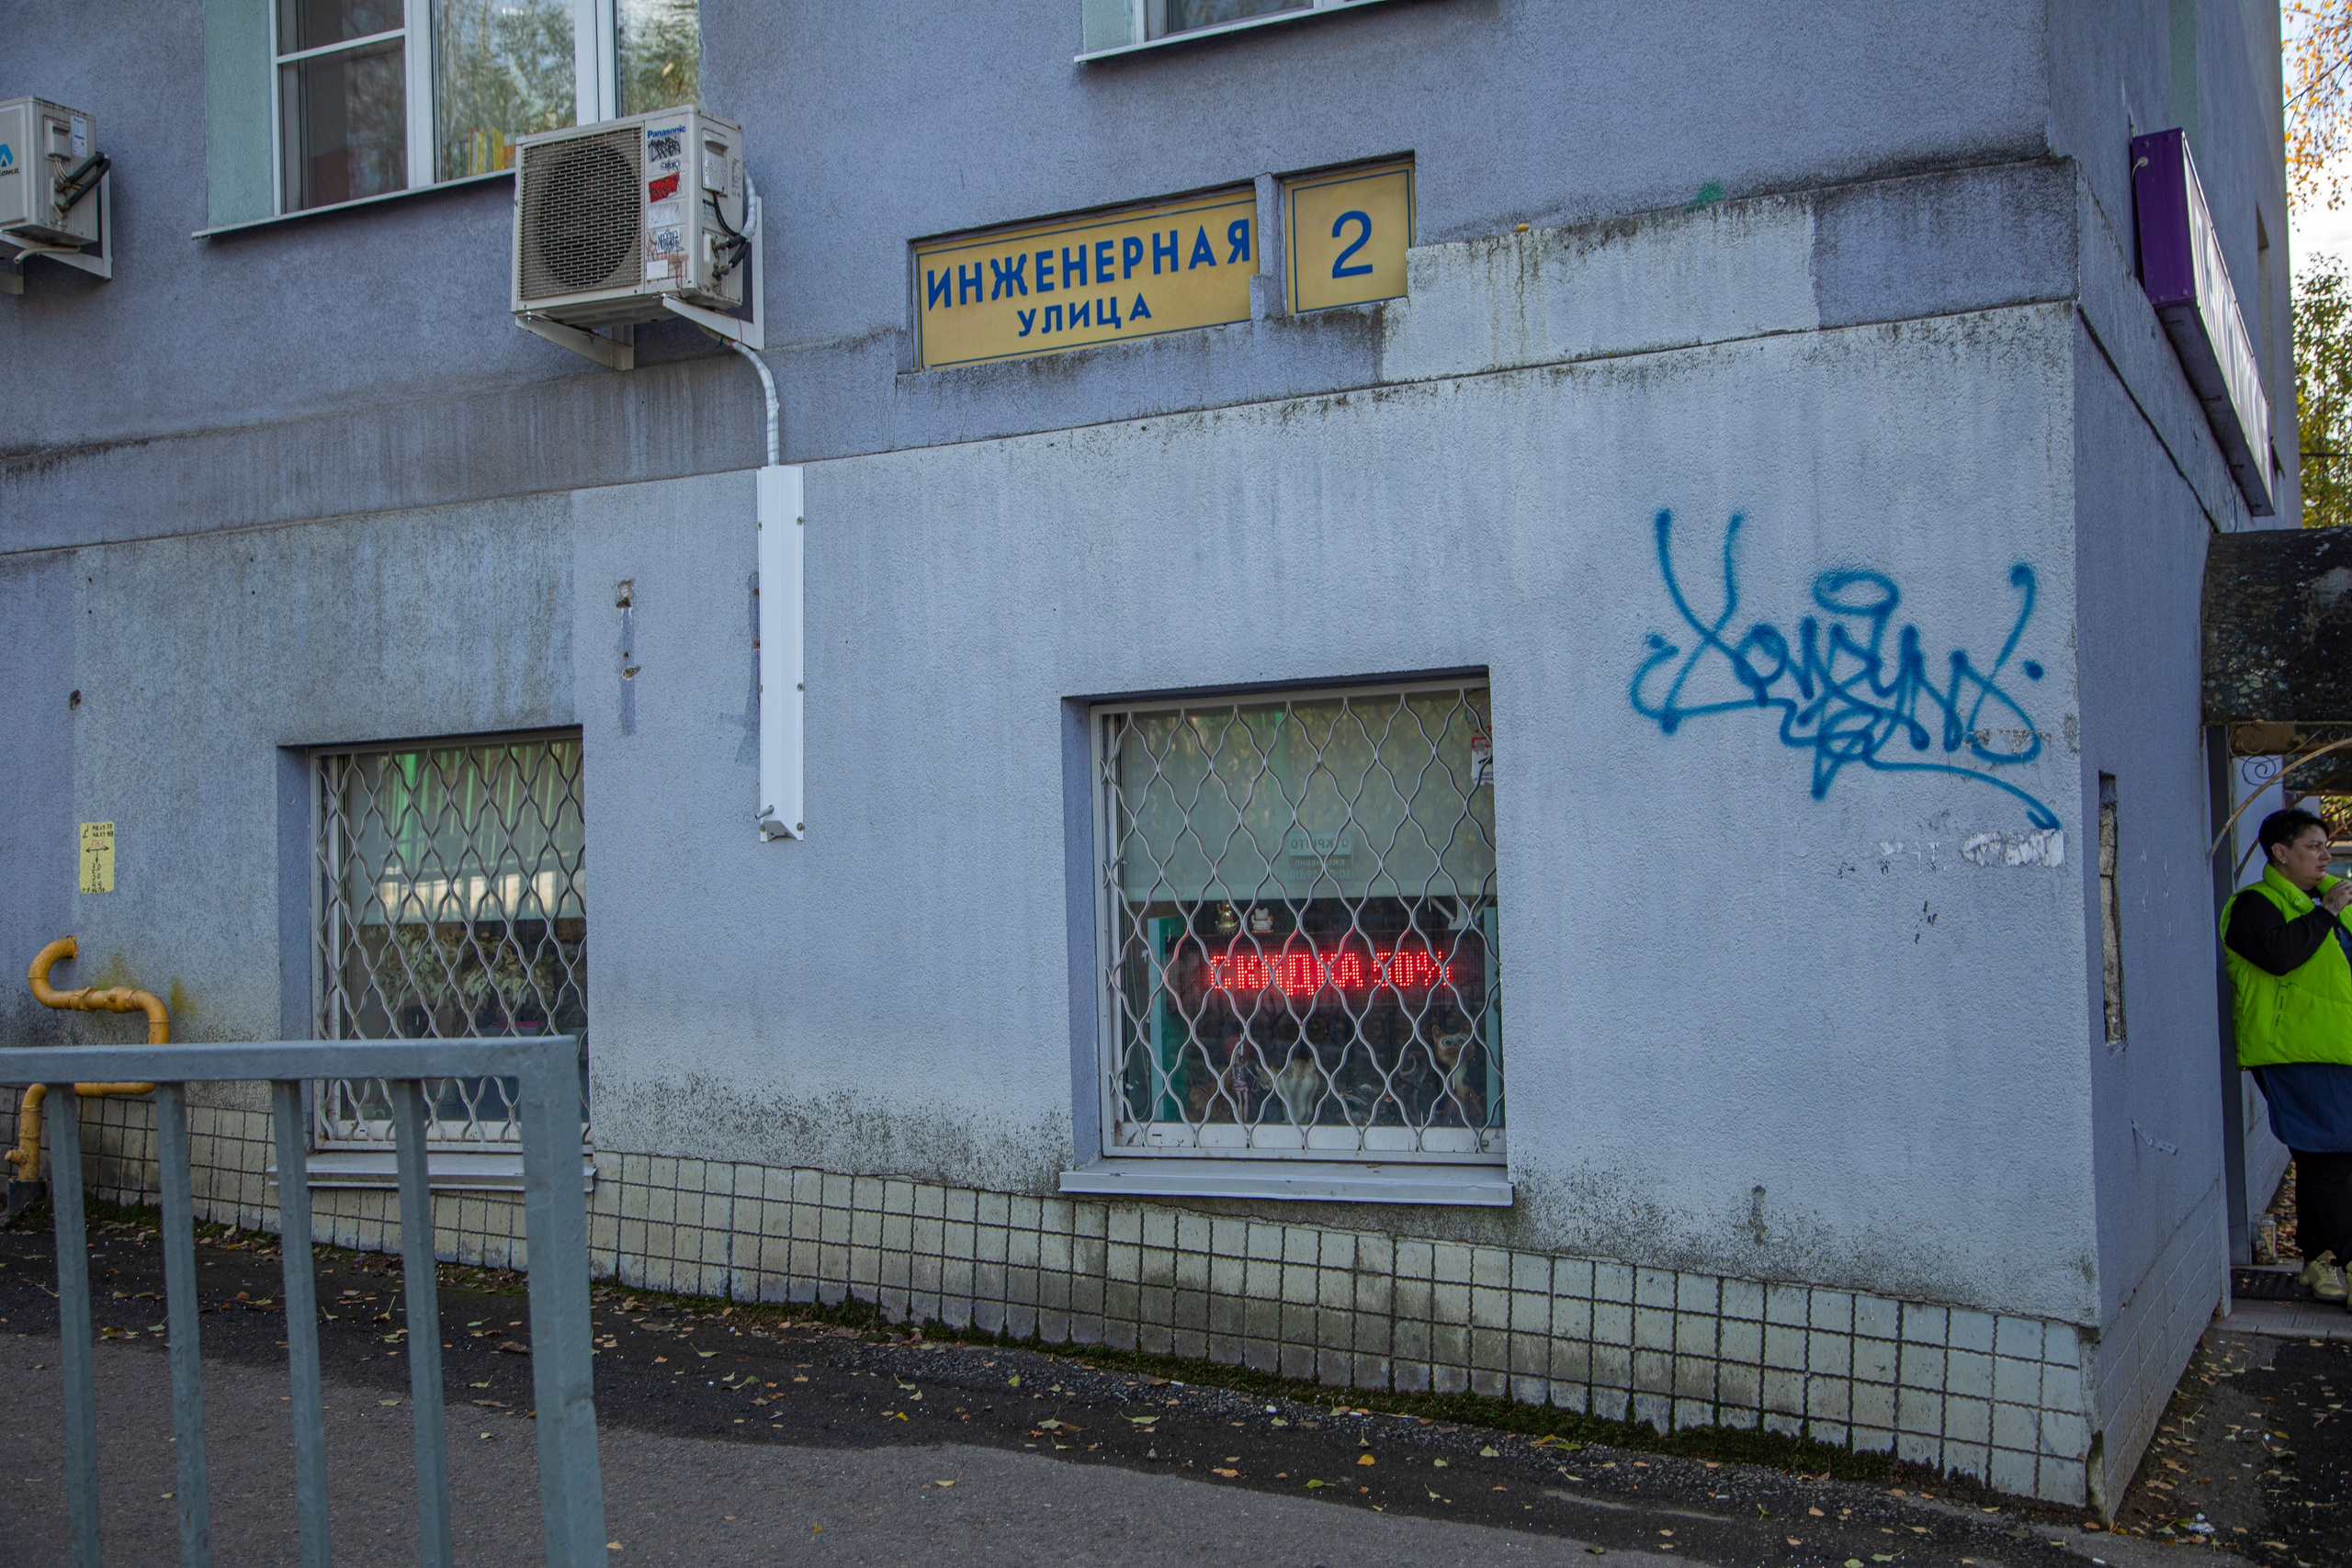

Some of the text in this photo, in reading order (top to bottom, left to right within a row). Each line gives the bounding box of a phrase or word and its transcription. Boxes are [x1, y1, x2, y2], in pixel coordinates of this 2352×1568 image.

[647, 125, 686, 139] Panasonic
[926, 217, 1251, 311] ИНЖЕНЕРНАЯ
[1330, 209, 1374, 279] 2
[1017, 291, 1152, 338] УЛИЦА
[1210, 950, 1453, 997] СКИДКА 50%
